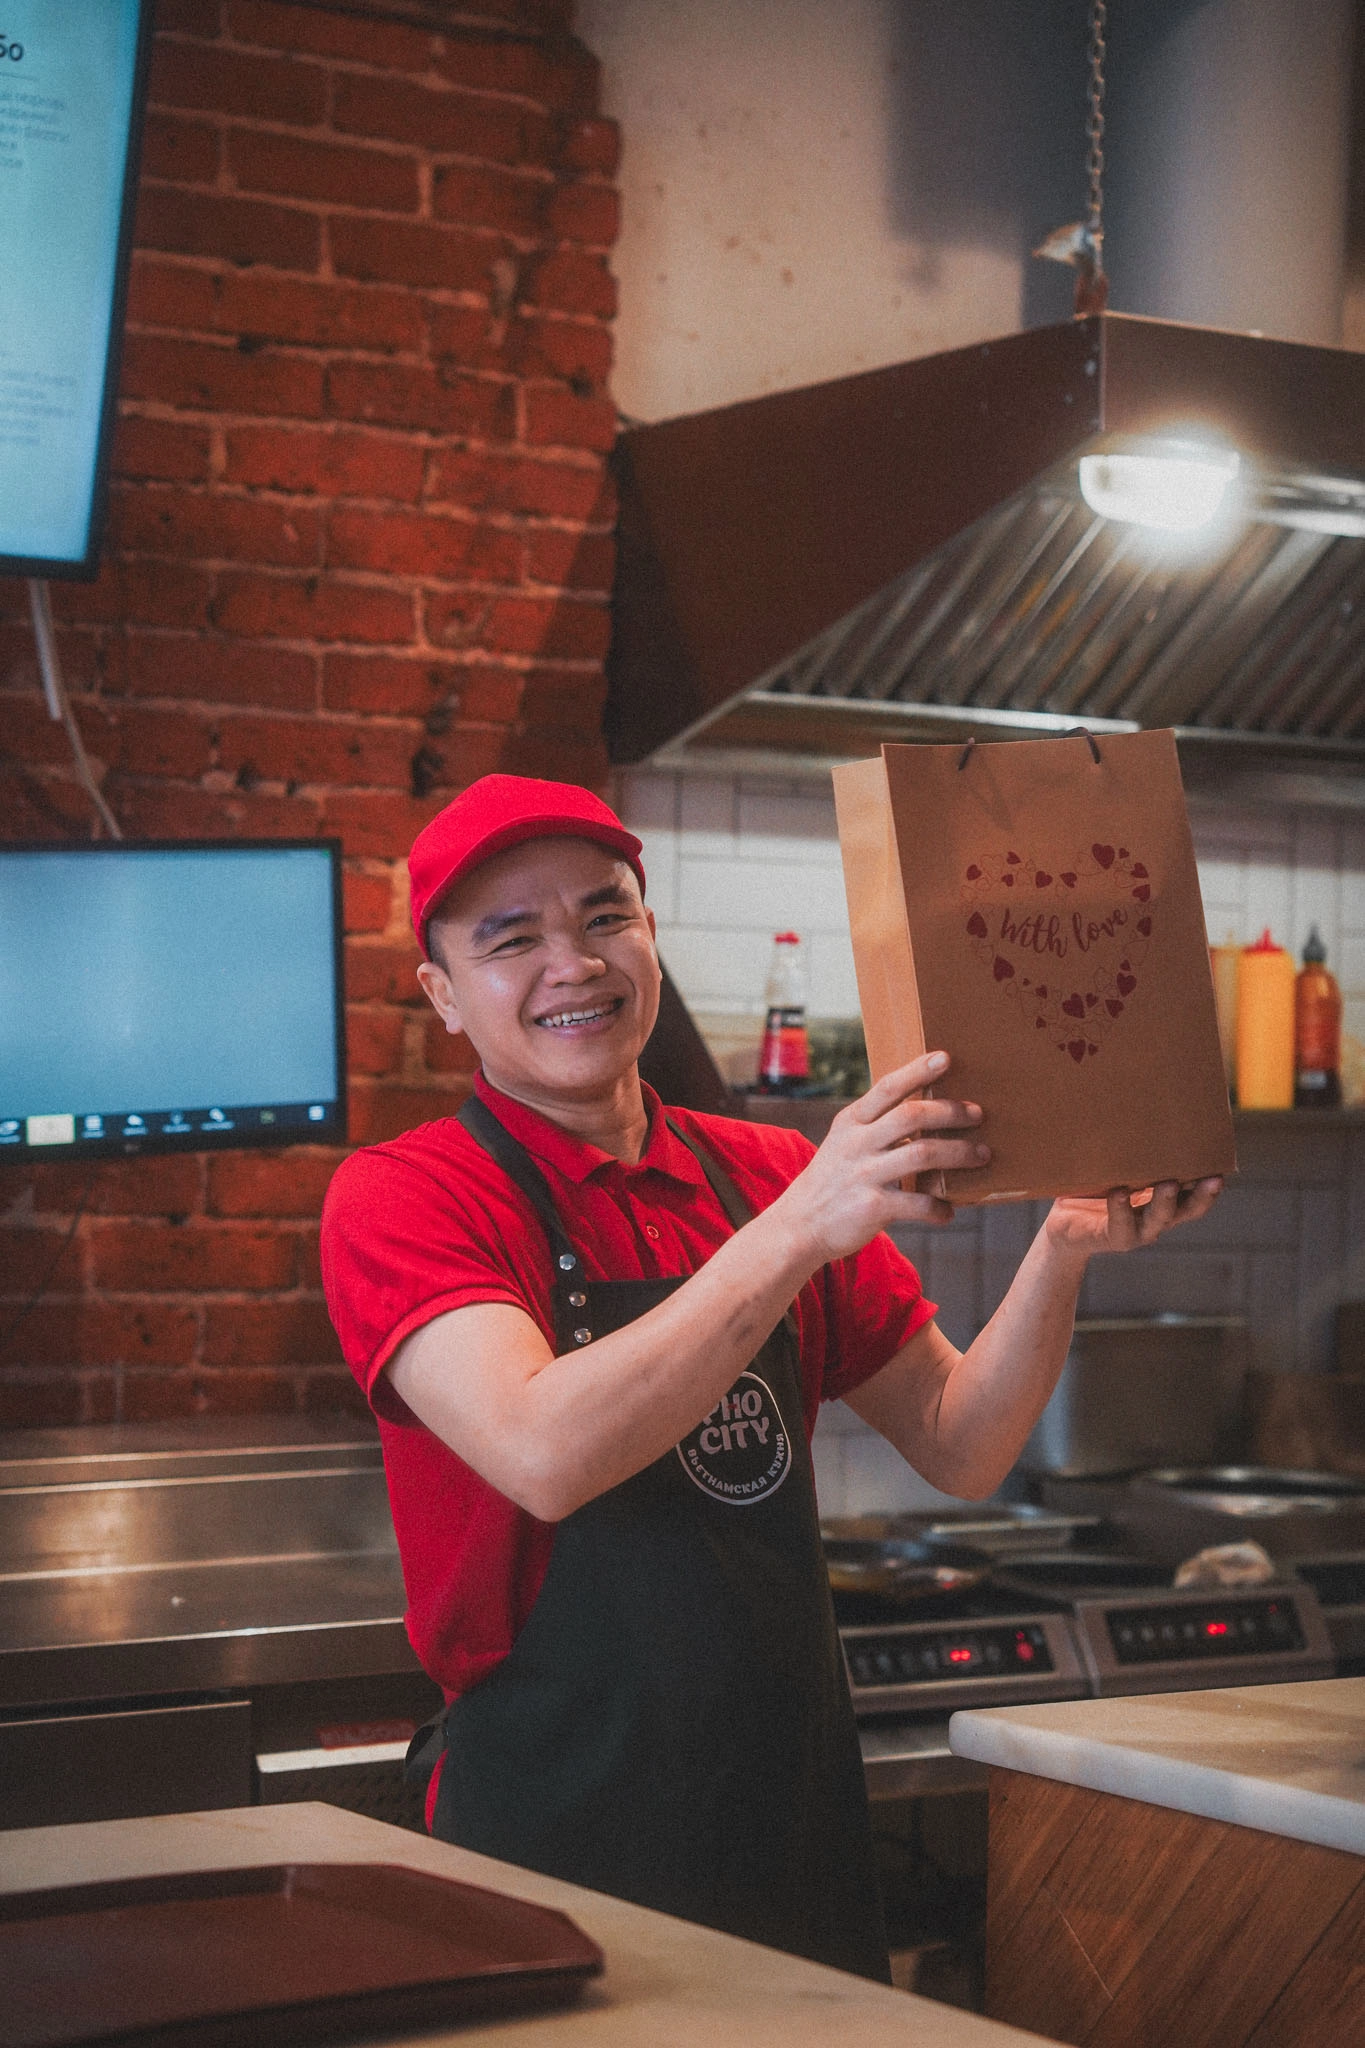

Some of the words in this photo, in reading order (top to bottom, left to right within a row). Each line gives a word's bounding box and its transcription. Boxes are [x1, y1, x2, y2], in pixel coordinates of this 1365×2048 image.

[1001, 908, 1068, 958] with
[1071, 909, 1128, 952] love
[700, 1416, 770, 1454] CITY
[687, 1448, 768, 1494] ВЬЕТНАМСКАЯ
[767, 1433, 785, 1477] КУХНЯ
